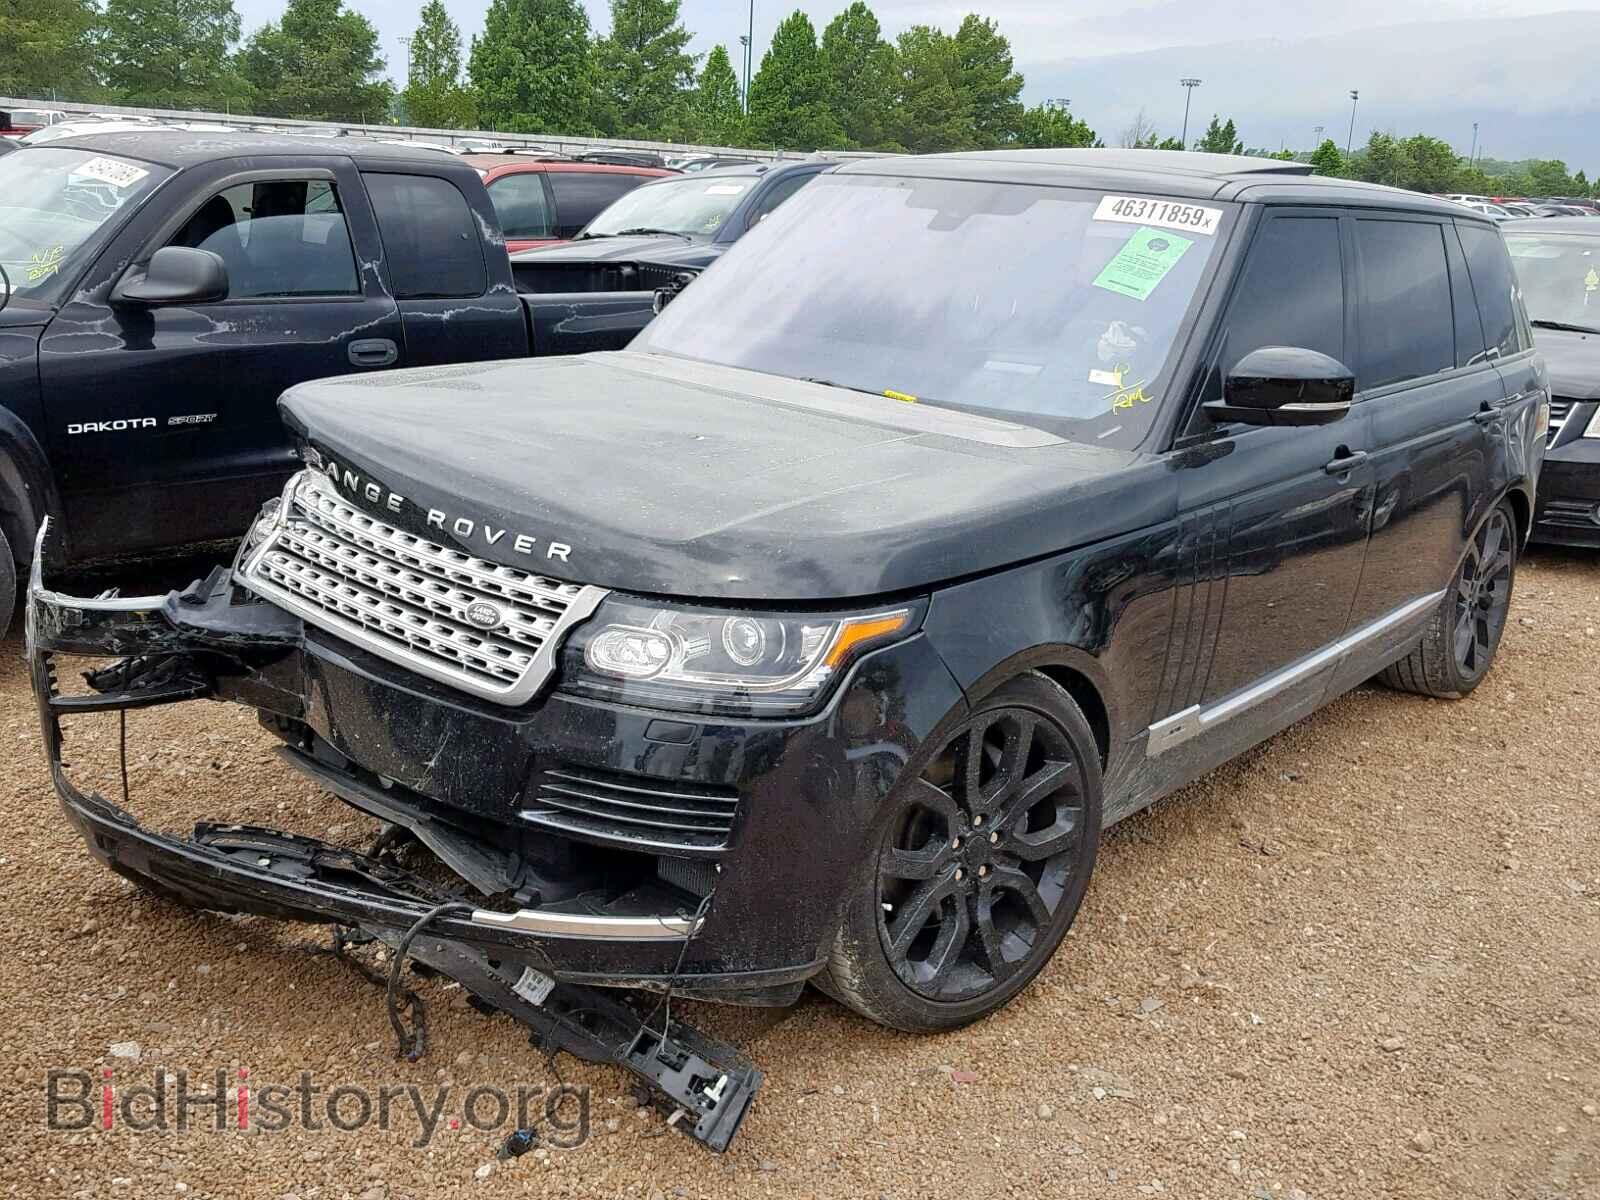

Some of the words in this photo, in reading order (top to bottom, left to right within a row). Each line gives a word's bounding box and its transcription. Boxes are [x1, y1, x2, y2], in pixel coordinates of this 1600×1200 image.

[67, 417, 157, 435] DAKOTA
[167, 412, 218, 426] SPORT
[426, 507, 573, 562] ROVER
